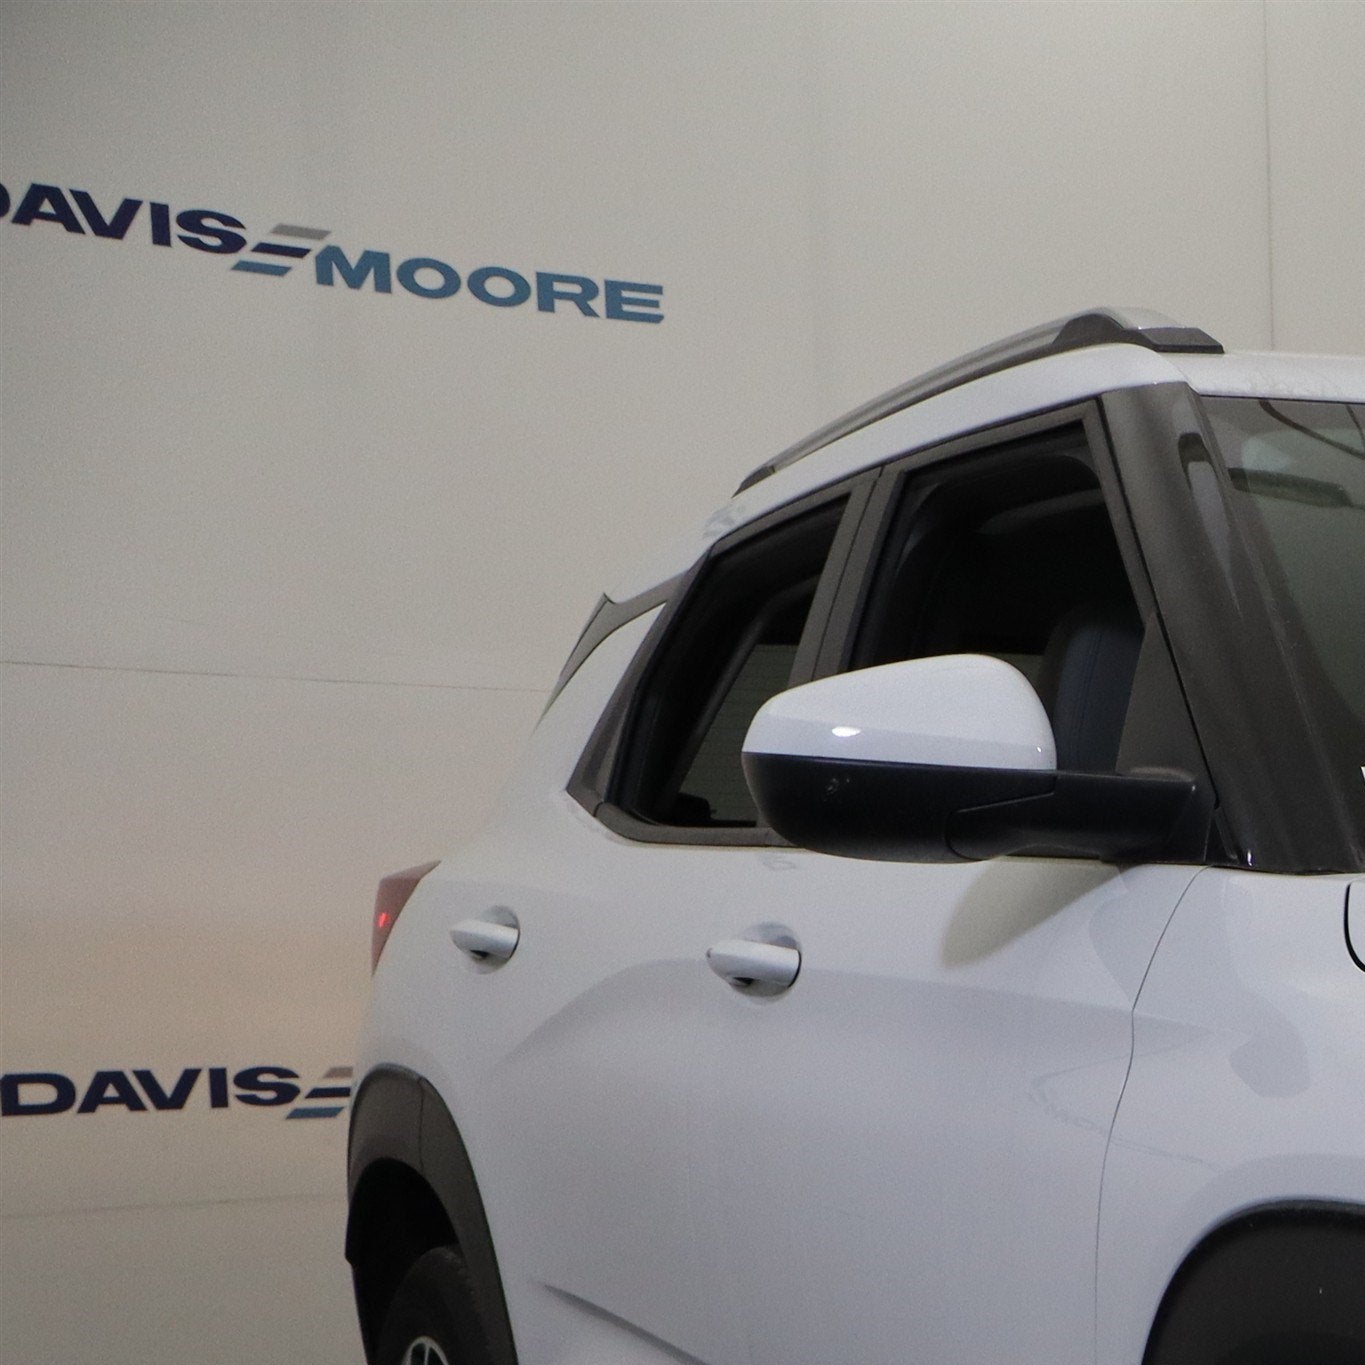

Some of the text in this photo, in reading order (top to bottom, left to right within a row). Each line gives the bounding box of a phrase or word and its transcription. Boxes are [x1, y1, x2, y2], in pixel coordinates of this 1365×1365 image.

[0, 181, 664, 324] AVIS MOORE
[0, 1066, 301, 1118] DAVIS
